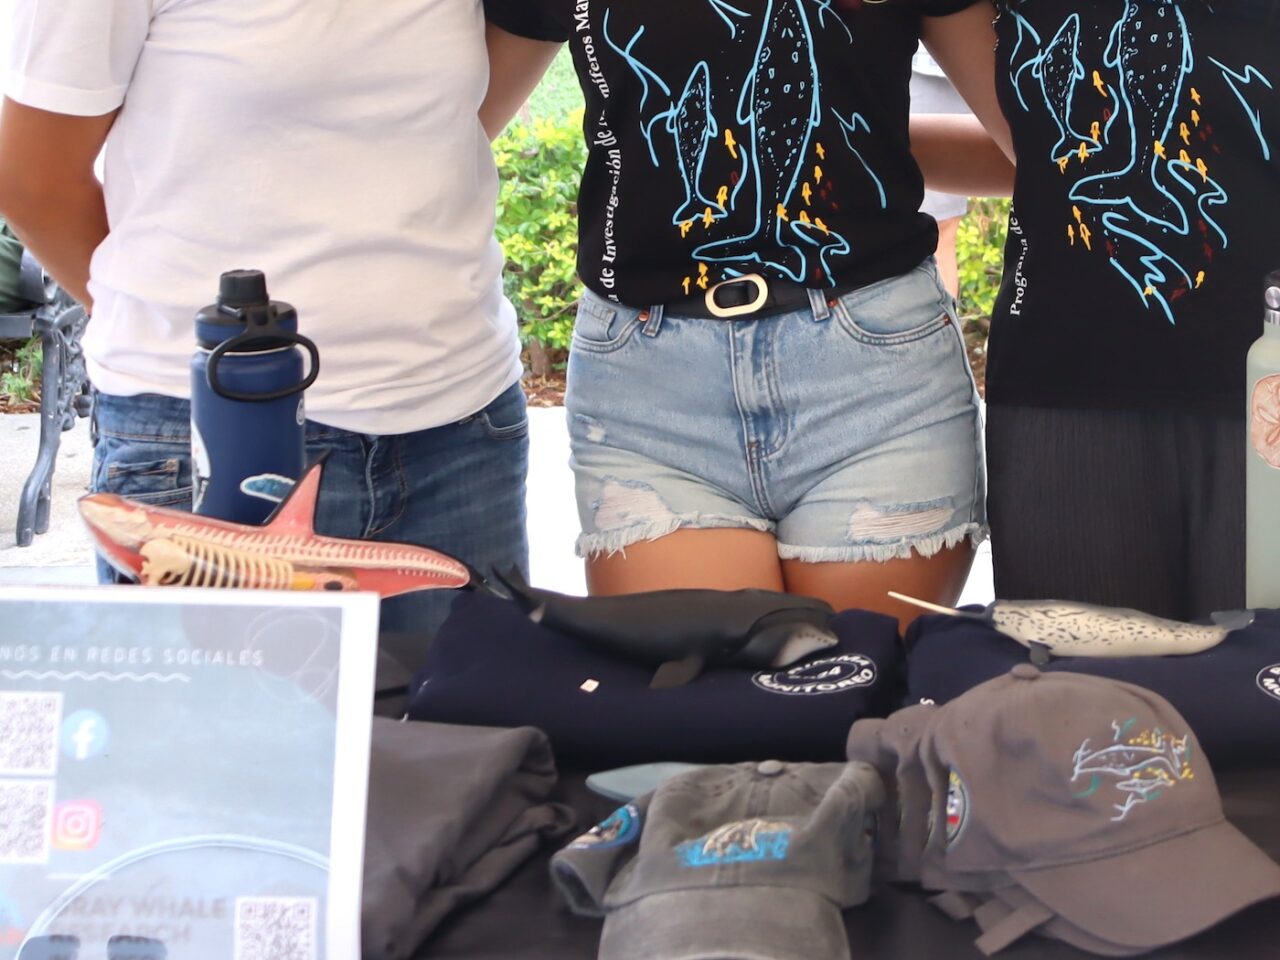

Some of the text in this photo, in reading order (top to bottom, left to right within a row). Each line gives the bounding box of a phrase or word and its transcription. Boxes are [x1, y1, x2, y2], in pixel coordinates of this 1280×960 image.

[594, 130, 618, 147] de
[599, 268, 615, 289] de
[51, 646, 77, 662] EN
[87, 647, 153, 663] REDES
[163, 647, 265, 666] SOCIALES
